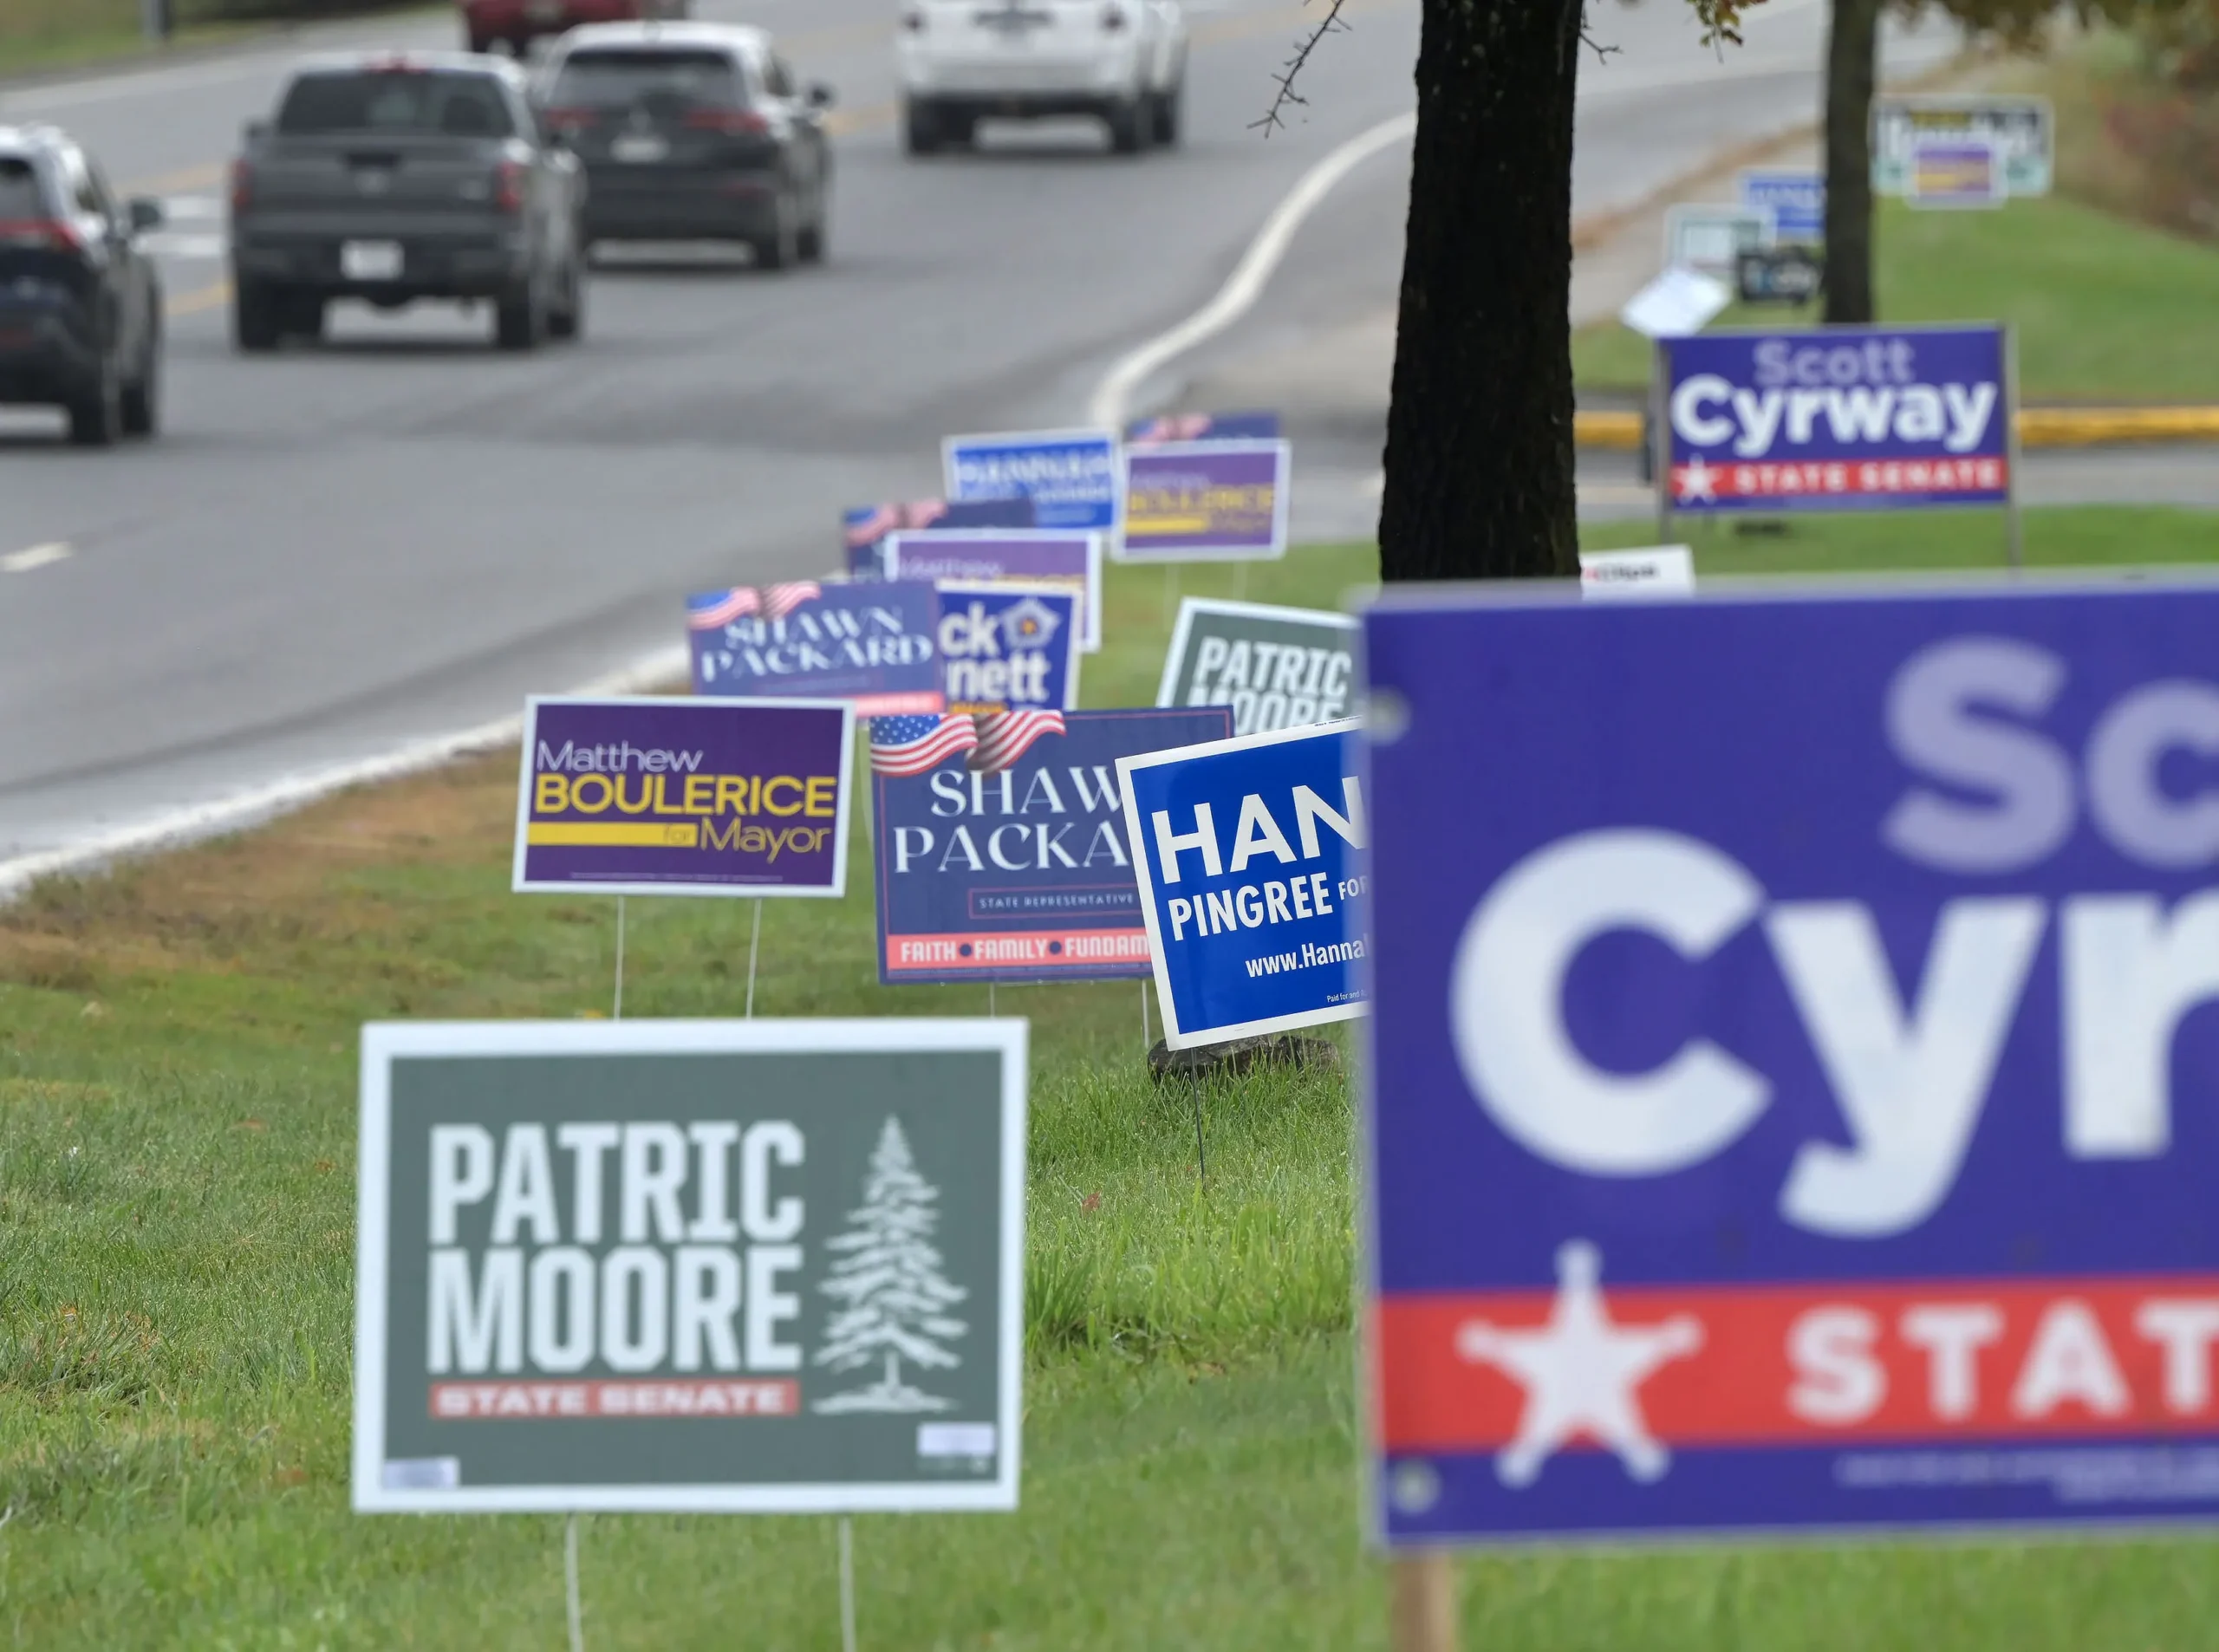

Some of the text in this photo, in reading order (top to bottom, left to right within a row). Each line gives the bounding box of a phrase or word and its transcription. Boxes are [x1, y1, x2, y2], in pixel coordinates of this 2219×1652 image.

[1753, 336, 1916, 387] Scott
[1670, 372, 1998, 459] Cyrway
[1734, 461, 1848, 495] STATE
[725, 607, 903, 649] SHAWN
[939, 601, 999, 658] ck
[701, 634, 934, 683] PACKARD
[943, 649, 1051, 704] nett
[1193, 635, 1352, 699] PATRIC
[537, 740, 703, 773] Matthew
[534, 773, 837, 817] BOULERICE
[700, 817, 832, 864] Mayor
[894, 822, 1130, 874] PACKA
[1151, 776, 1370, 885] HAN
[979, 892, 1134, 908] STATE REPRESENTATIVE
[1167, 872, 1333, 941] PINGREE
[901, 940, 957, 963] FAITH
[974, 937, 1048, 960] FAMILY
[1327, 993, 1339, 1003] Paid
[1340, 992, 1349, 1000] for
[429, 1118, 804, 1246] PATRIC
[426, 1245, 804, 1375] MOORE
[436, 1382, 787, 1417] STATE SENATE
